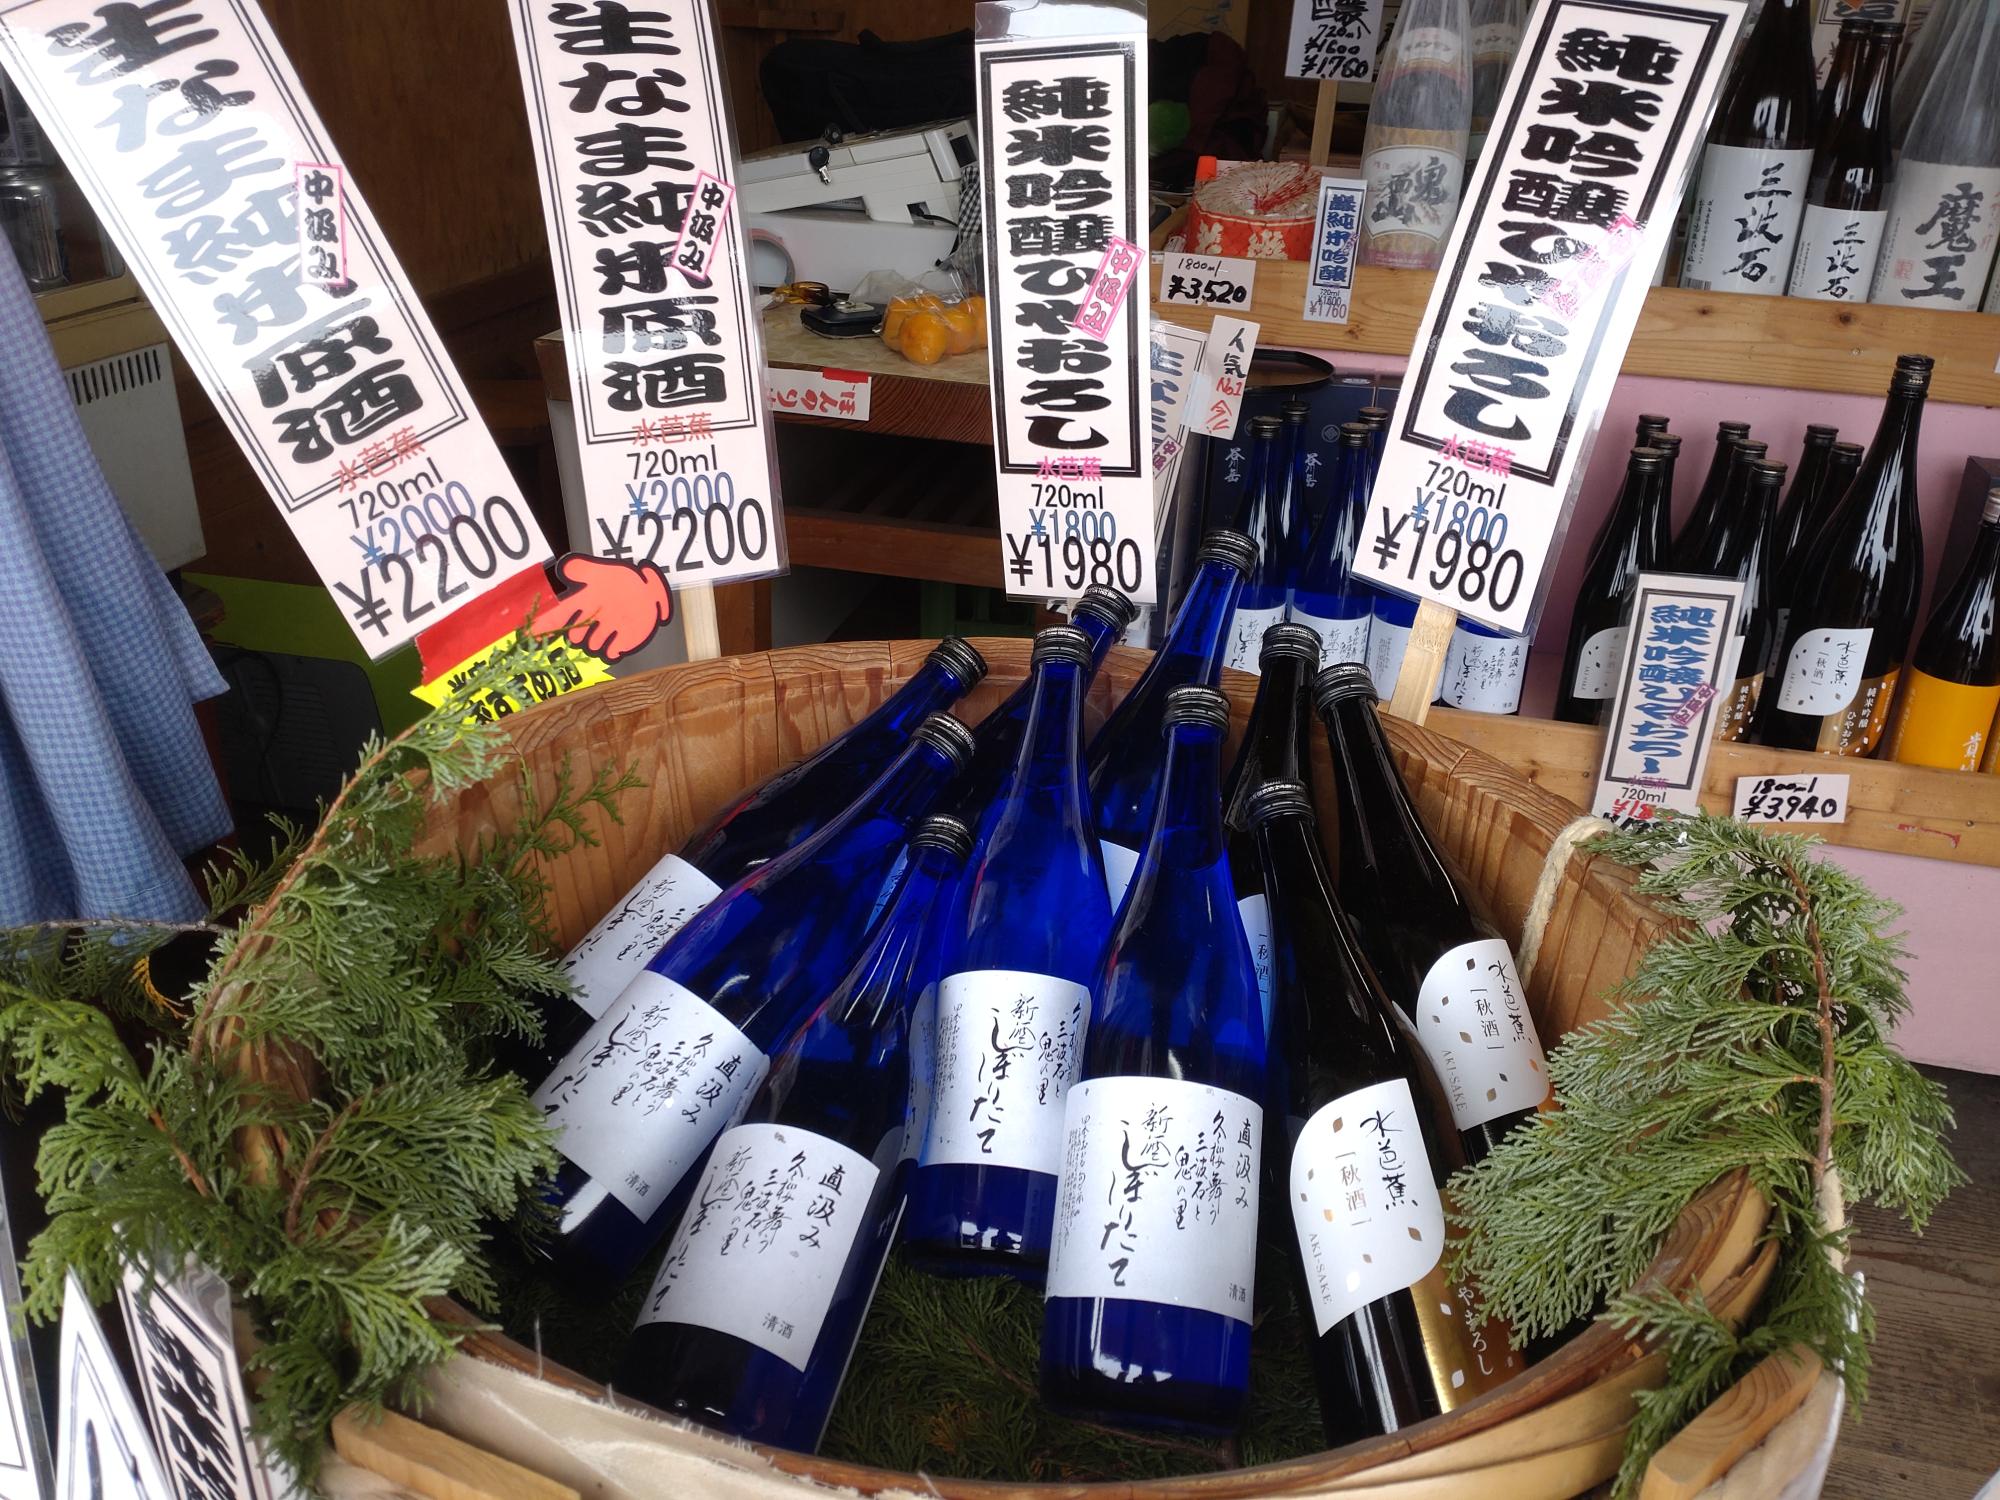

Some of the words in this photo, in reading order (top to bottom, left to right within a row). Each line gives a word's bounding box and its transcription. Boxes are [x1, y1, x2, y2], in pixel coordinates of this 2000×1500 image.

[304, 169, 341, 280] 中汲み
[678, 182, 724, 272] 中汲み
[1723, 163, 1792, 283] 三波石
[1901, 182, 1984, 300] 魔王
[1002, 76, 1112, 450] 純米吟醸ひやおろし
[1083, 248, 1133, 331] 中汲み
[1817, 222, 1866, 299] 三波石
[631, 412, 714, 447] 水芭蕉
[768, 385, 856, 416] ほんのり
[331, 426, 426, 494] 水芭蕉
[627, 444, 718, 480] 720ml
[1036, 456, 1102, 481] 水芭蕉
[1425, 460, 1507, 509] 720ml
[1439, 434, 1517, 478] 水芭蕉
[338, 473, 443, 528] 720ml
[350, 481, 478, 566] ¥2000
[625, 472, 735, 520] ¥2000
[1029, 509, 1116, 547] ¥1800
[1031, 484, 1104, 510] 720ml
[1411, 487, 1508, 553] ¥1800
[333, 496, 531, 638] ¥2200
[596, 498, 768, 574] ¥2200
[1007, 533, 1142, 594] ¥1980
[1373, 506, 1524, 612] ¥1980
[1621, 787, 1667, 803] 720ml
[682, 1055, 742, 1126] 直汲み
[1235, 1118, 1252, 1208] 直汲み
[800, 1165, 846, 1249] 直汲み
[1308, 1232, 1333, 1306] AKI-SAKE
